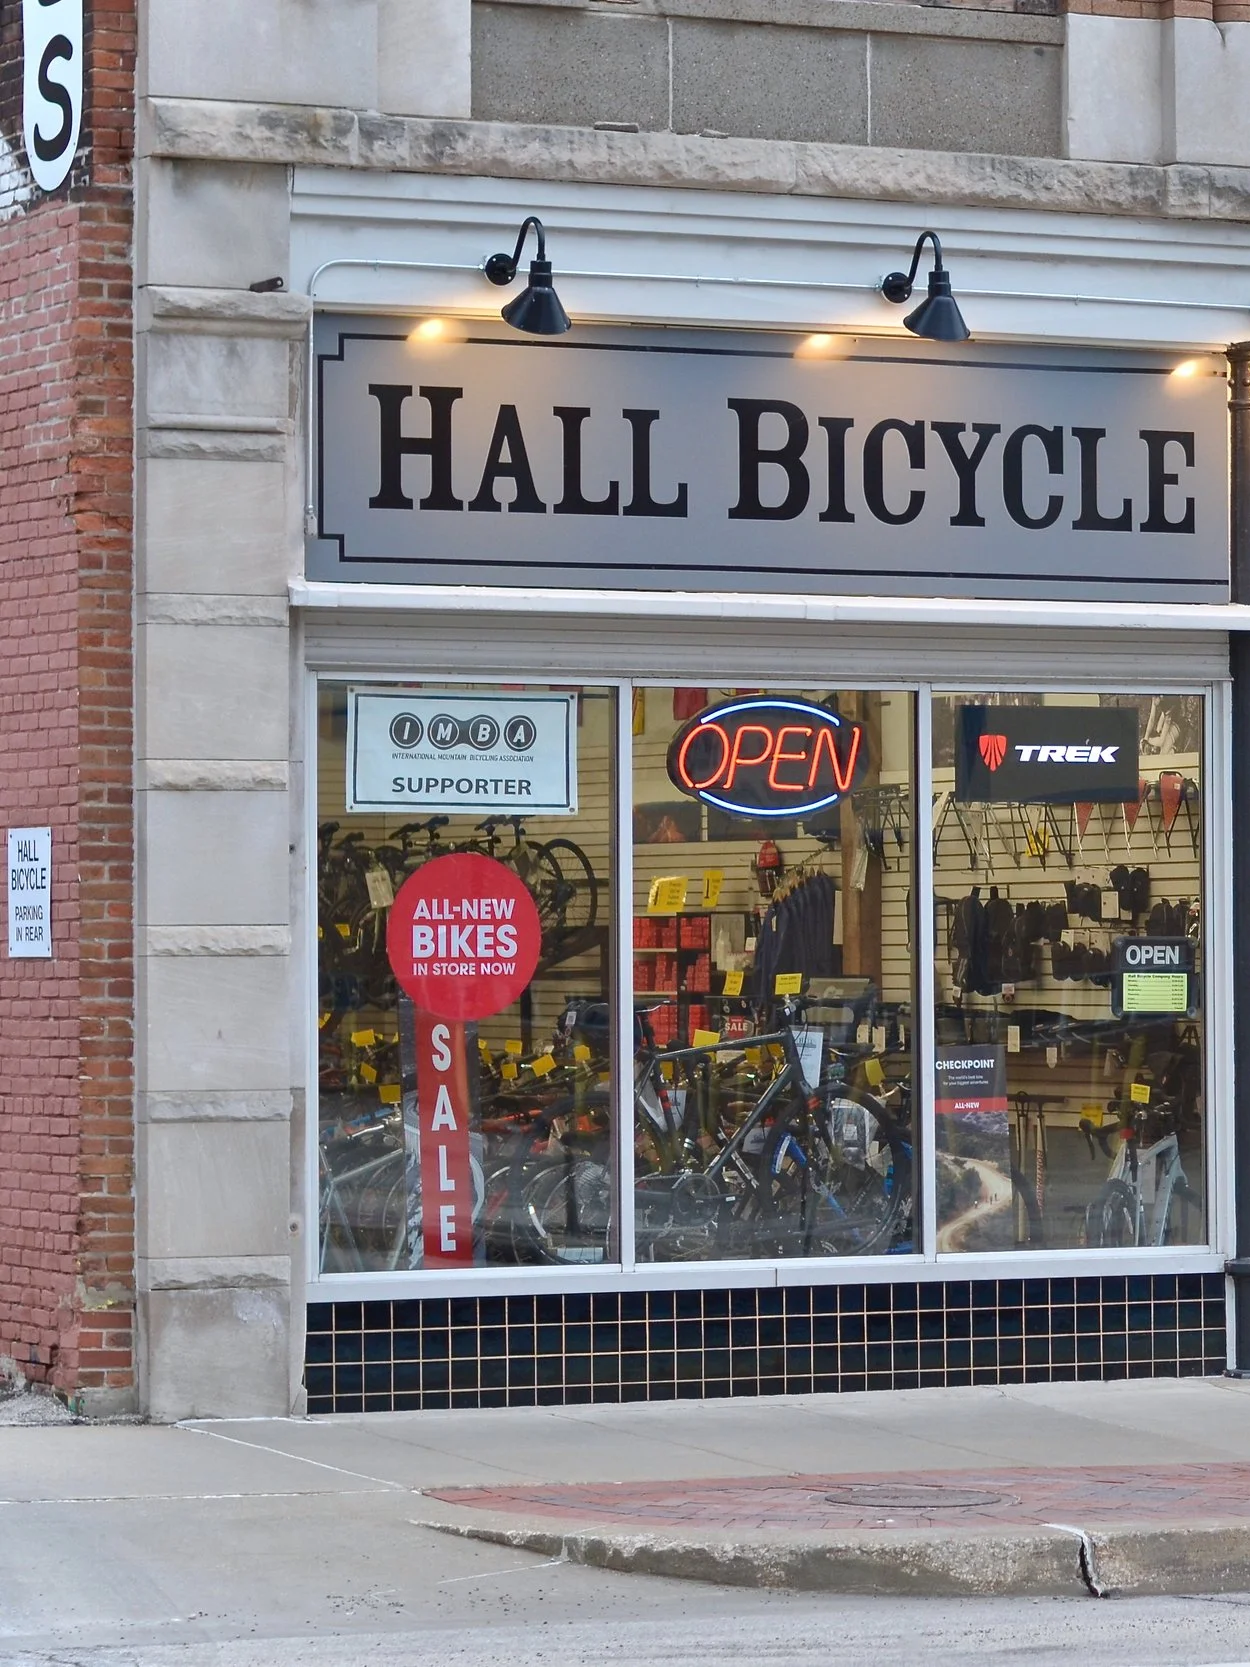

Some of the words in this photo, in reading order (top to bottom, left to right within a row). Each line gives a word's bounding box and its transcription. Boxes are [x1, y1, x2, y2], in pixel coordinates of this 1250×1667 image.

[33, 0, 73, 162] S
[368, 383, 688, 518] HALL
[727, 397, 1196, 534] BICYCLE
[396, 717, 531, 747] IMBA
[391, 752, 436, 760] INTERNATIONAL
[469, 754, 498, 762] BICYCLING
[678, 723, 861, 793] OPEN
[1014, 745, 1120, 763] TREK
[391, 776, 532, 796] SUPPORTER
[17, 839, 39, 862] HALL
[11, 867, 46, 891] BICYCLE
[15, 904, 43, 921] PARKING
[412, 898, 516, 920] ALL-NEW
[15, 926, 23, 942] IN
[25, 926, 44, 942] REAR
[411, 924, 518, 959] BIKES
[1126, 945, 1179, 965] OPEN
[413, 963, 428, 976] IN
[432, 963, 476, 976] STORE
[480, 962, 516, 976] NOW
[724, 1022, 749, 1032] SALE
[935, 1059, 995, 1070] CHECKPOINT
[431, 1022, 458, 1252] SALE
